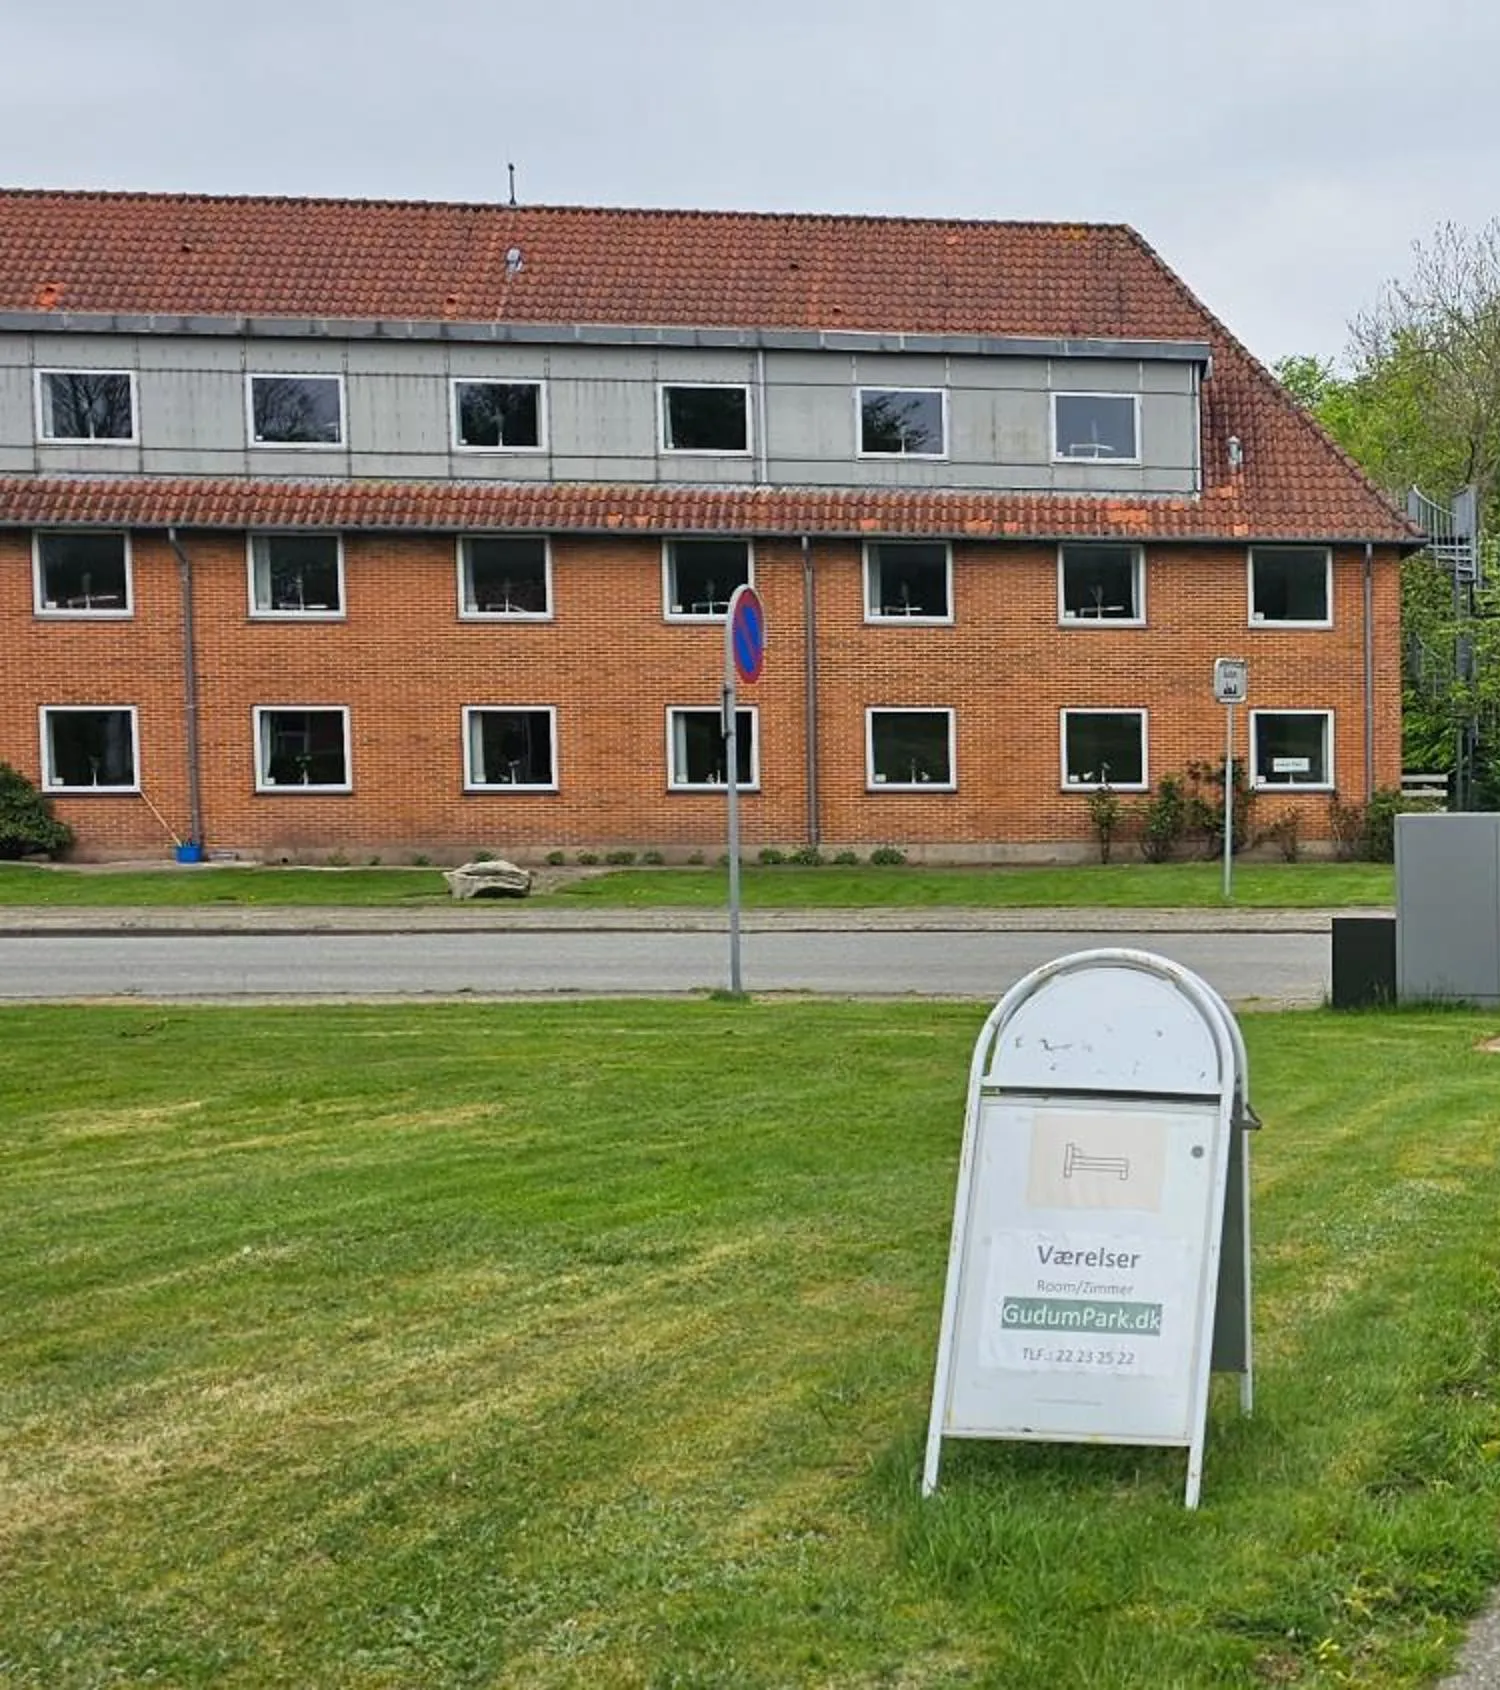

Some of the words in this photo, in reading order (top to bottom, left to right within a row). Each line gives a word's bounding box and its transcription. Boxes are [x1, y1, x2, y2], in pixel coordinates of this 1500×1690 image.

[1037, 1245, 1141, 1268] Værelser
[1037, 1279, 1133, 1295] Room/Zimmer
[1003, 1304, 1161, 1329] GudumPark.dk
[1056, 1349, 1073, 1362] 22
[1117, 1352, 1135, 1365] 22
